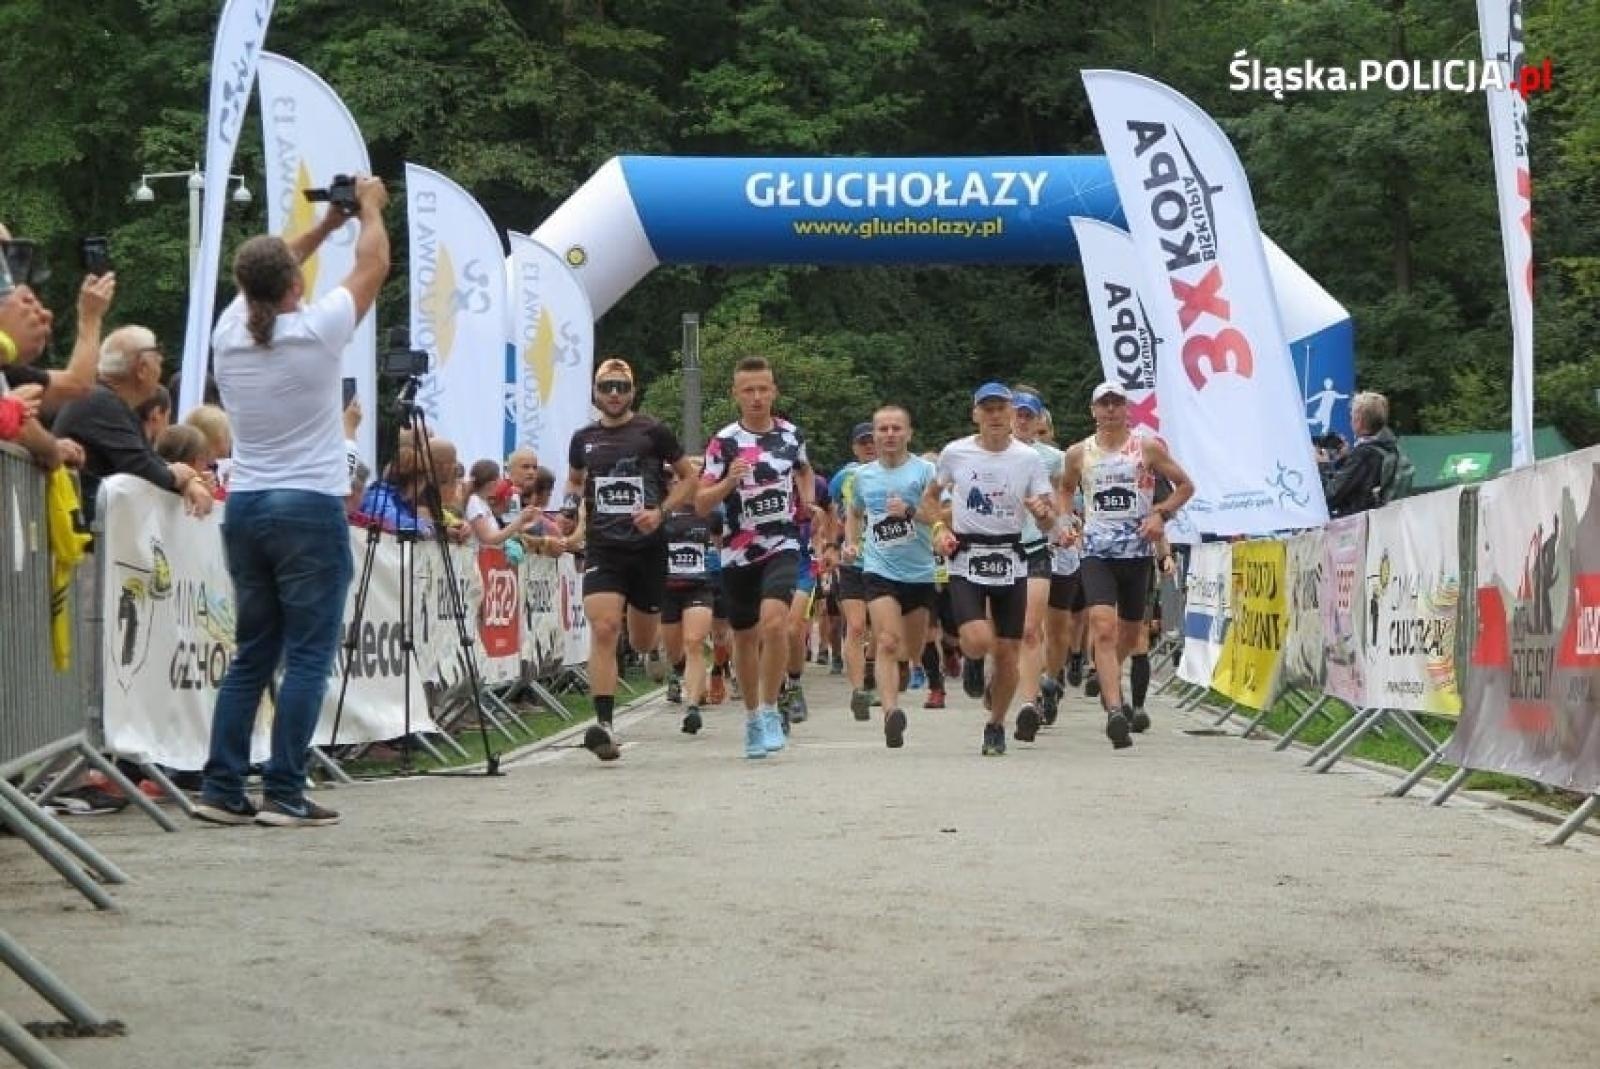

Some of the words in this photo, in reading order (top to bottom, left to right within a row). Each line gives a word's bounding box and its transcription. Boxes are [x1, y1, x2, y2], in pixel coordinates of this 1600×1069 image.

[745, 171, 1048, 208] GŁUCHOŁAZY
[756, 497, 778, 512] 333
[1104, 495, 1125, 506] 361
